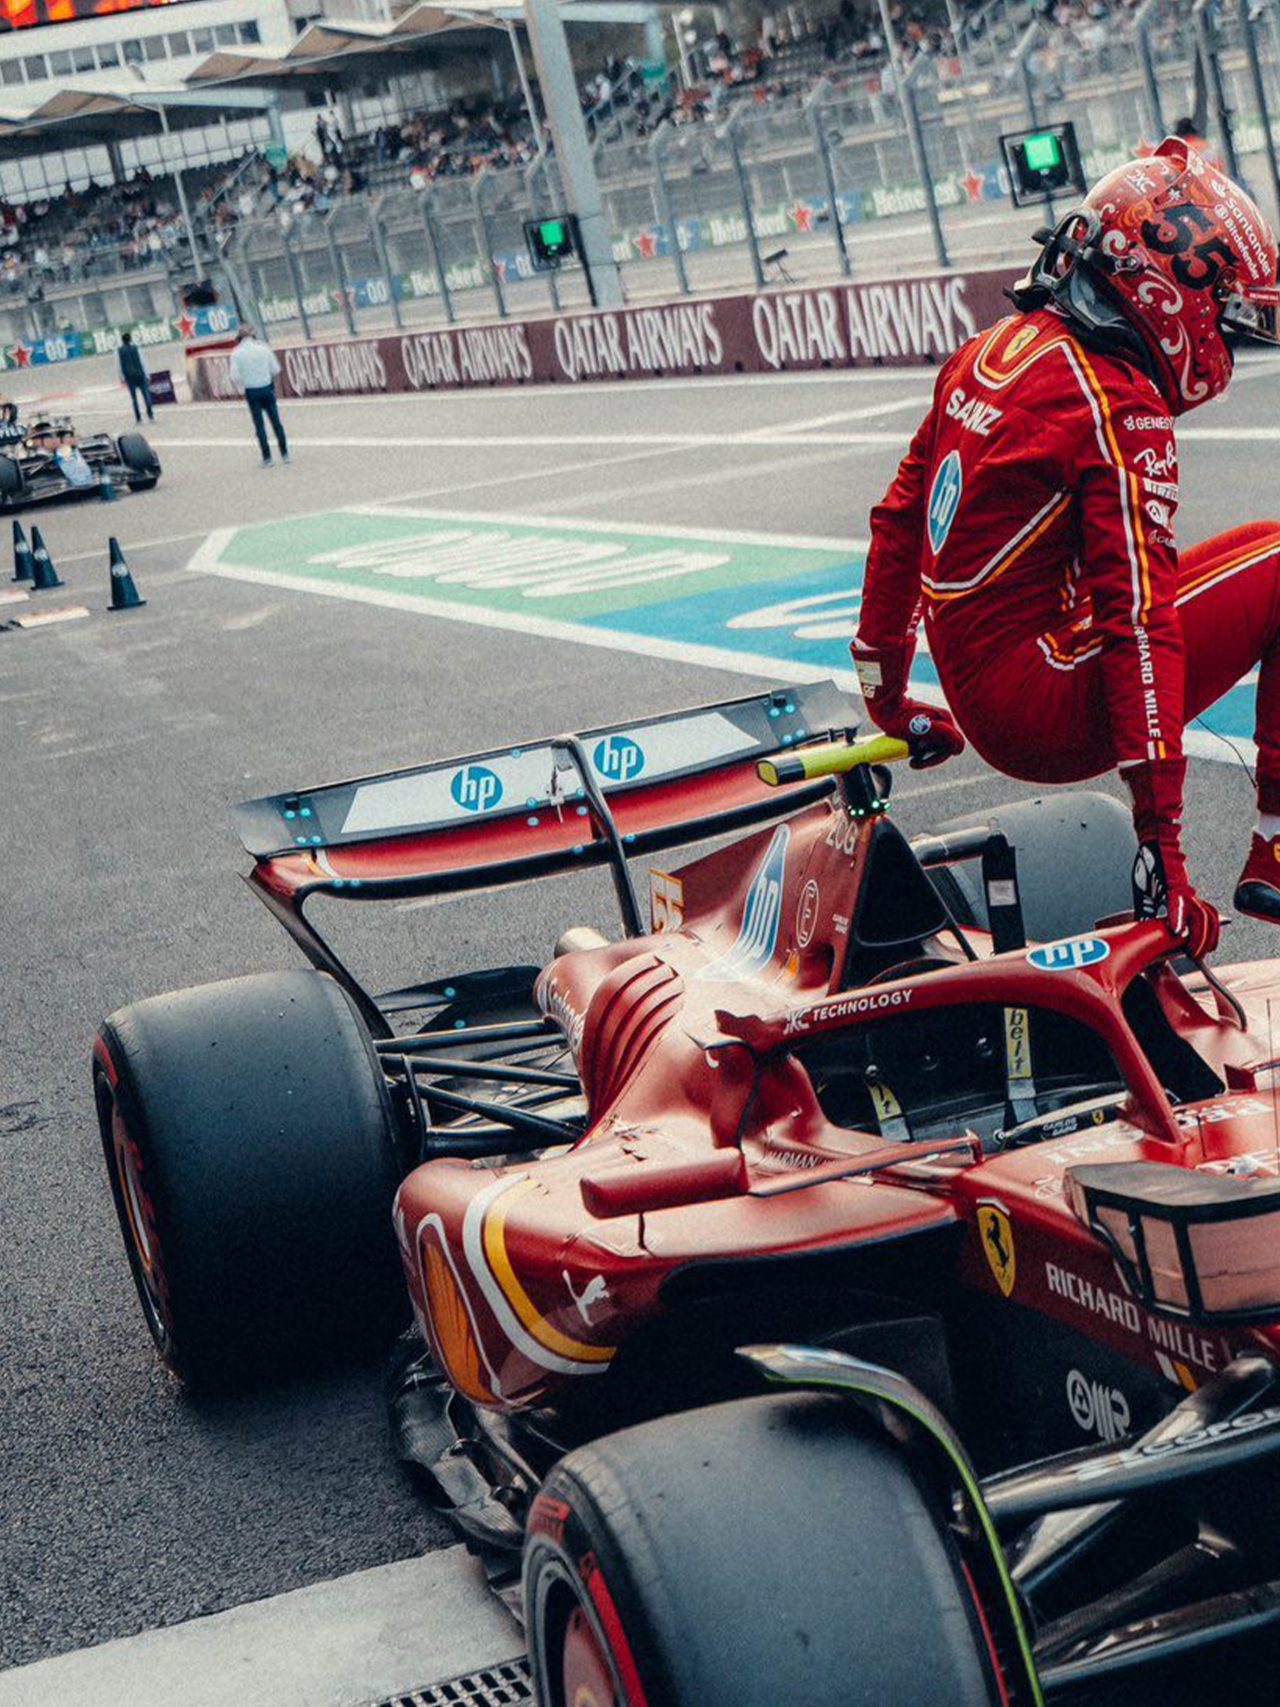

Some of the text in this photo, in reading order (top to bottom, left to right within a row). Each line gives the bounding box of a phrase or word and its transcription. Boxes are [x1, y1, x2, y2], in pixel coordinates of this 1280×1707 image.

[1141, 202, 1241, 291] 55
[1223, 216, 1260, 281] Bitdefender
[1225, 198, 1272, 278] Santander
[401, 323, 533, 389] QATAR AIRWAYS
[554, 303, 724, 381] QATAR AIRWAYS
[752, 277, 977, 369] QATAR AIRWAYS
[1144, 689, 1161, 738] MILLE
[460, 767, 496, 812] hp
[602, 736, 636, 781] hp
[812, 989, 913, 1023] TECHNOLOGY
[1008, 1009, 1024, 1076] belt
[1046, 1262, 1218, 1374] RICHARD MILLE
